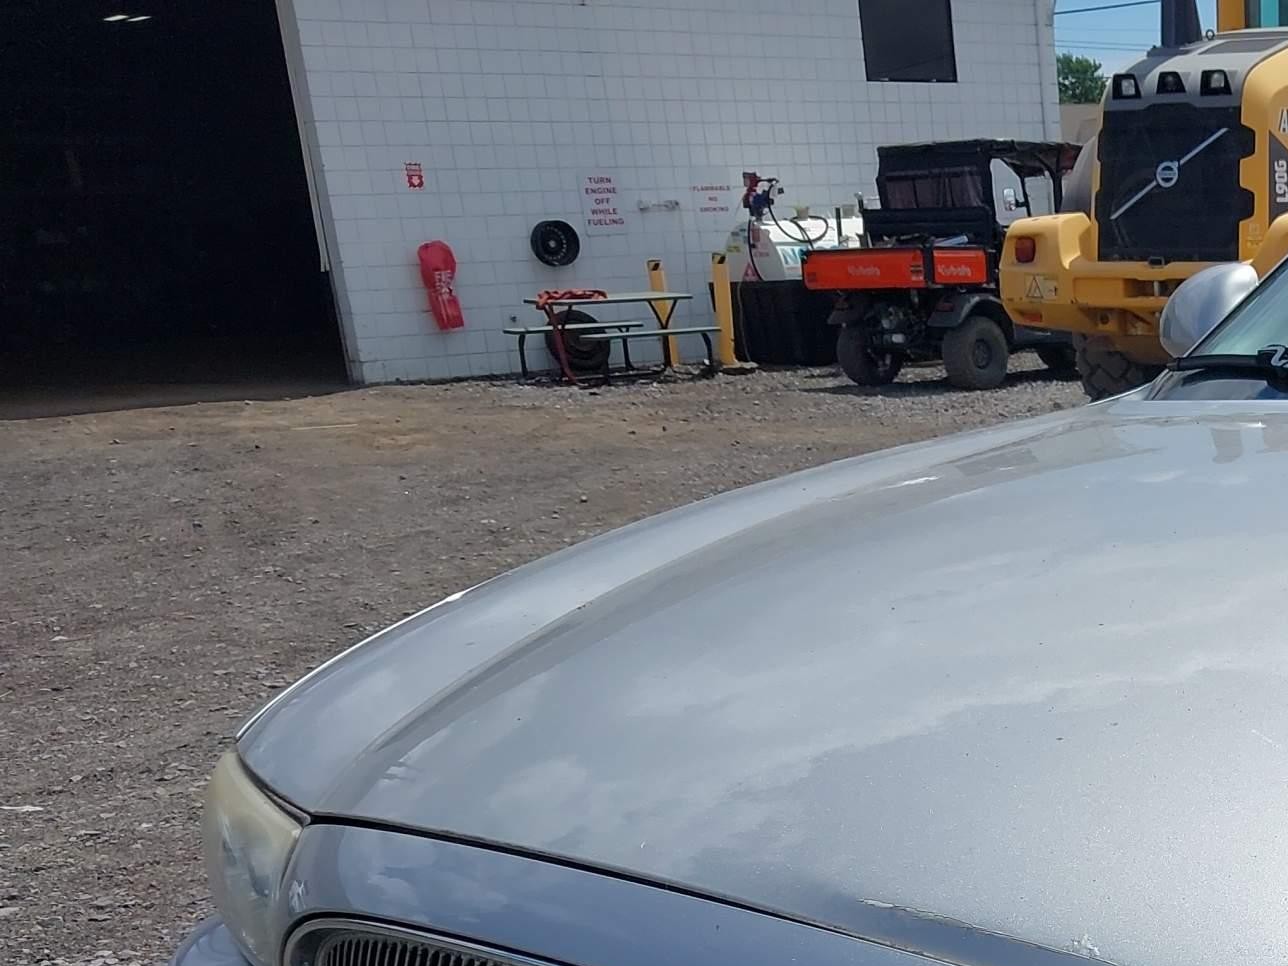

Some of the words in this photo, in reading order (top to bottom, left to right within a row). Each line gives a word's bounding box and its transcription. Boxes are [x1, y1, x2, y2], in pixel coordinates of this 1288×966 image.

[587, 176, 612, 184] TURN
[1274, 159, 1288, 203] L90G
[585, 187, 617, 195] ENGINE
[587, 217, 625, 226] FUELING
